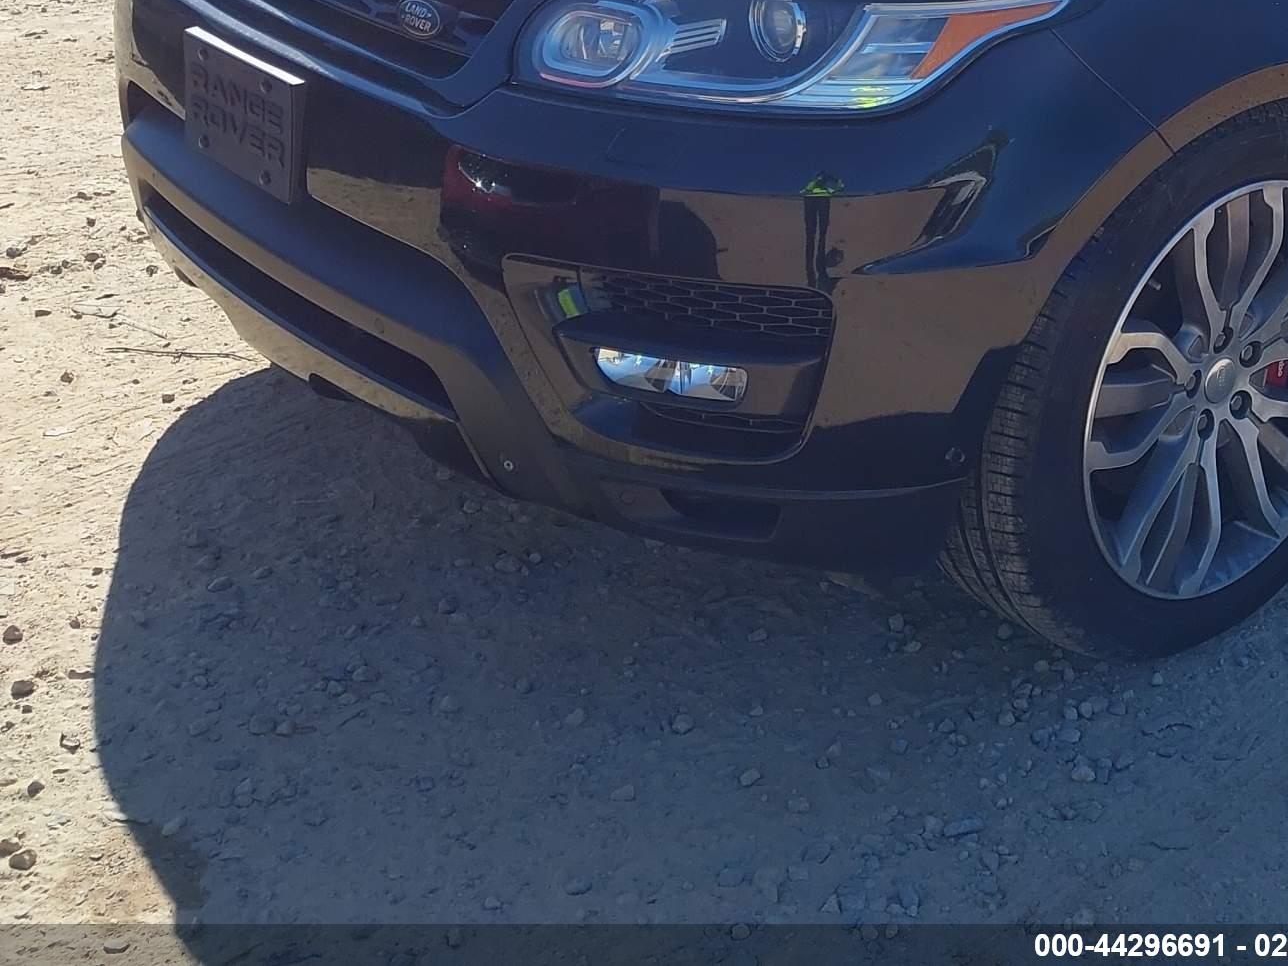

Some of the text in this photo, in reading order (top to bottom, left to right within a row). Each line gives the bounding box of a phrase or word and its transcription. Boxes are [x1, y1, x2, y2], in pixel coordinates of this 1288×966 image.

[404, 14, 432, 32] ROVER
[405, 2, 428, 18] LAND
[192, 61, 283, 133] RANGE
[192, 93, 285, 168] ROVER
